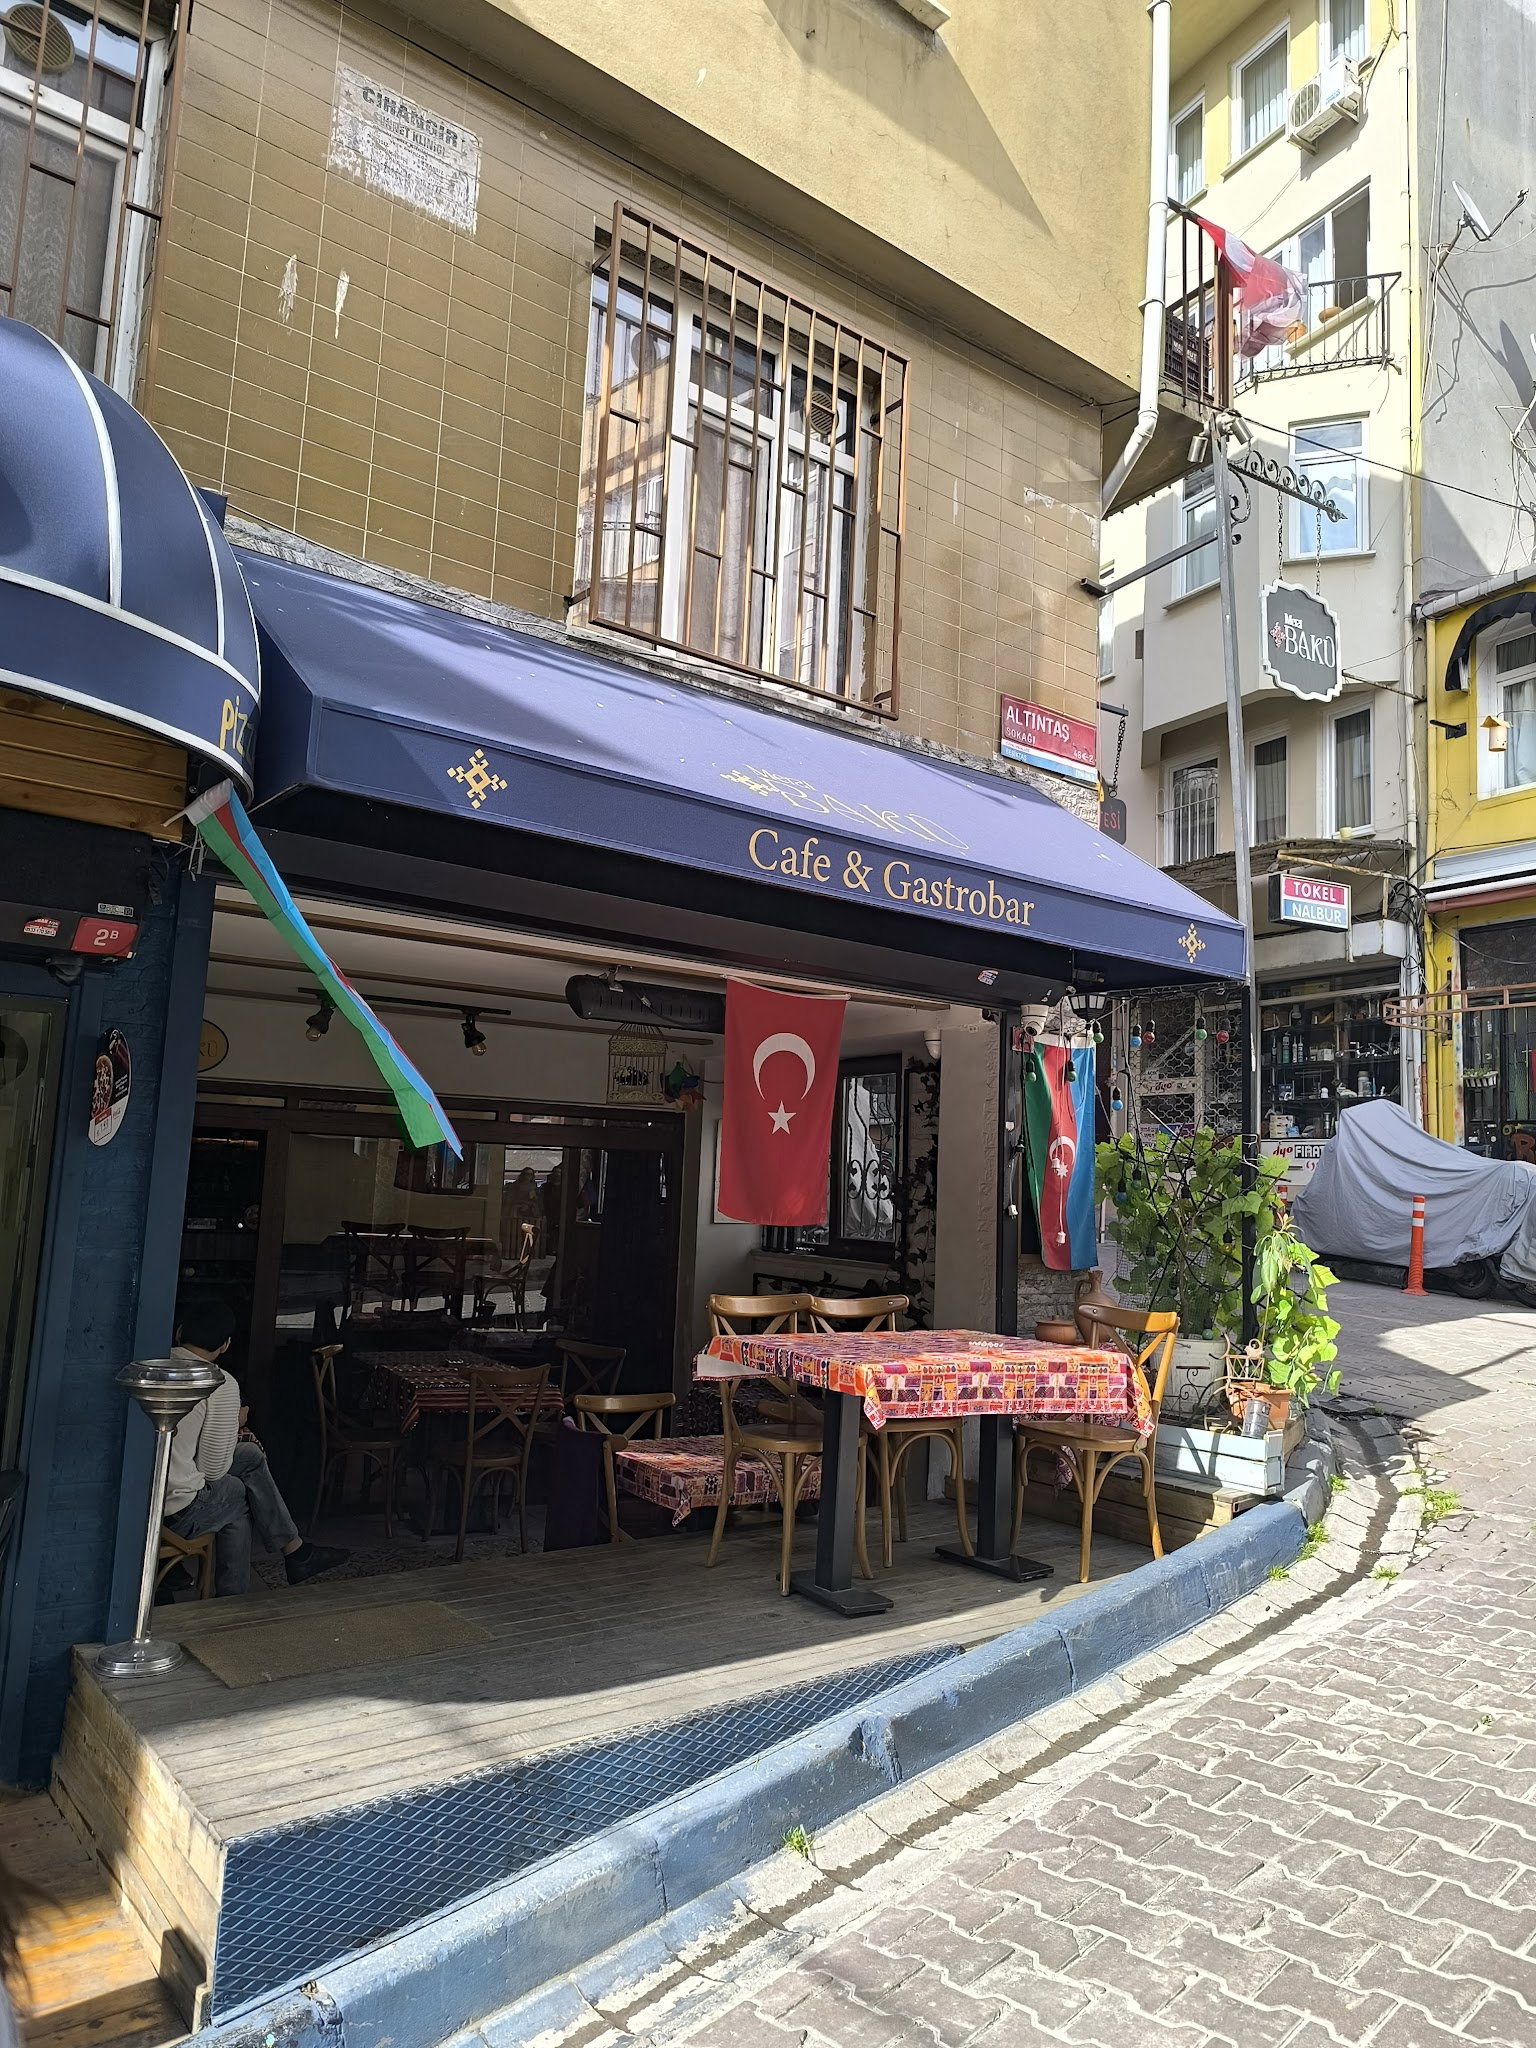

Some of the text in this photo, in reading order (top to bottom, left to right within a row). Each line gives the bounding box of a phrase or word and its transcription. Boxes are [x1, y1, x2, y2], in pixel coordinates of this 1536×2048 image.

[1006, 705, 1070, 742] ALTINTAŞ
[1006, 727, 1036, 745] SOKAĞI
[748, 828, 1035, 926] Cafe & Gastrobar
[1293, 881, 1336, 902] TOKEL
[1292, 903, 1341, 923] NALBUR
[1273, 1146, 1293, 1158] dyo
